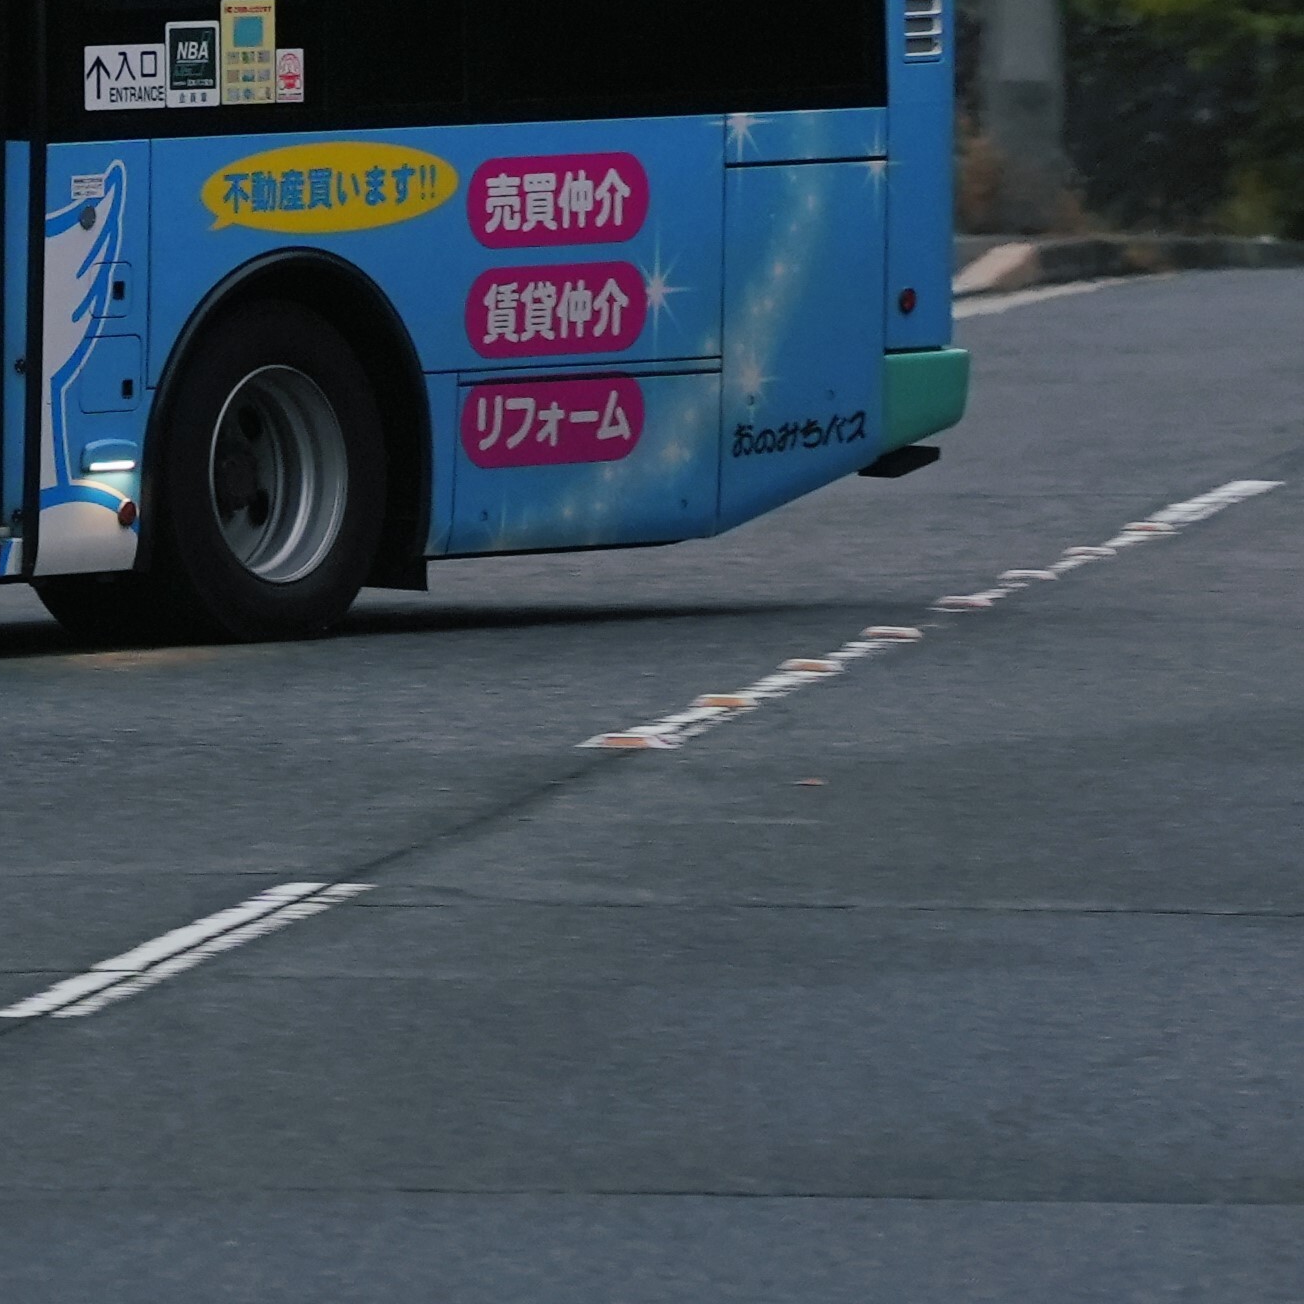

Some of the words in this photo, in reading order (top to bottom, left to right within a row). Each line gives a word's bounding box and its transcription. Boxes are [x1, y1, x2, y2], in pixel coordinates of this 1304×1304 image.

[114, 50, 158, 82] 入口
[176, 41, 210, 61] NBA
[109, 85, 165, 104] ENTRANCE
[222, 163, 438, 215] 不動産買います!!
[483, 166, 631, 234] 売買仲介
[481, 275, 631, 345] 賃貸仲介
[473, 388, 632, 453] リフォーム
[731, 409, 868, 460] おのみちバス
